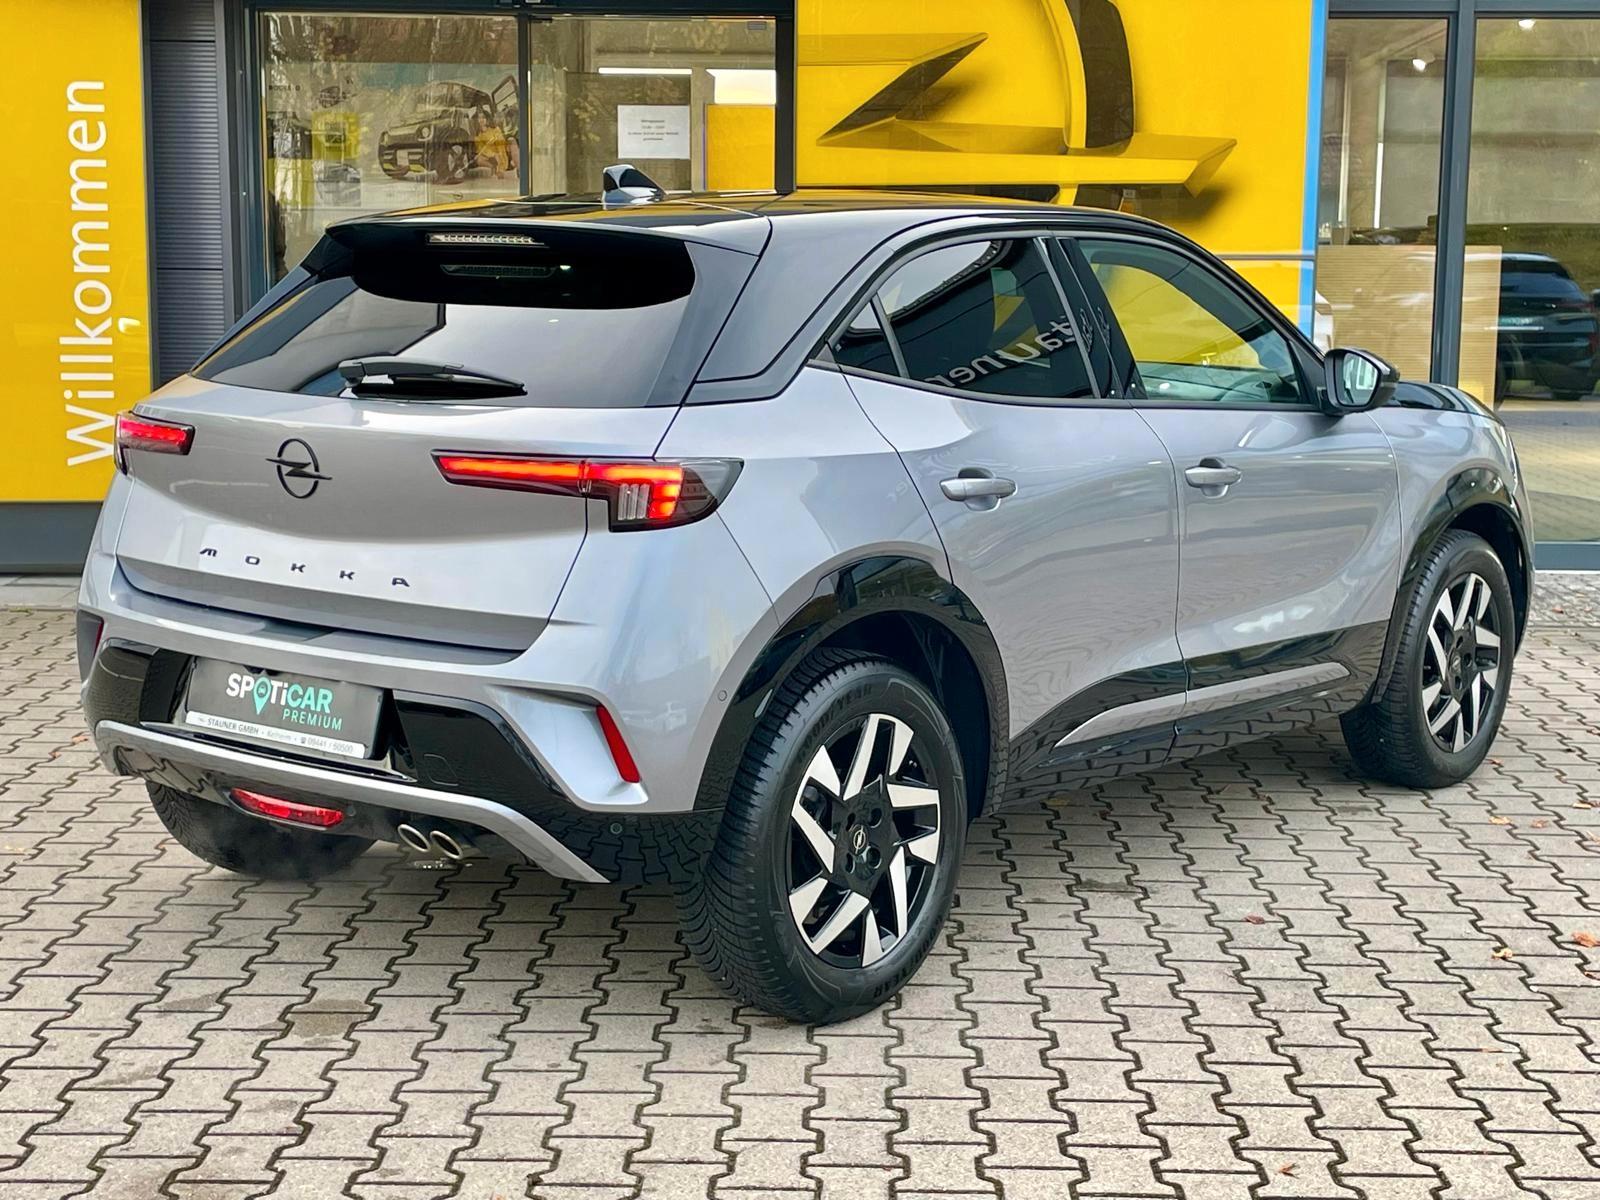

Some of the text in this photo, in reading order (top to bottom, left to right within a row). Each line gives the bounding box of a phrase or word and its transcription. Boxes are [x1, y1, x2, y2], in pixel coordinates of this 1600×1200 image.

[59, 80, 115, 466] Willkommen
[200, 547, 410, 587] MOKKA
[207, 717, 237, 733] STAUNER
[282, 708, 342, 731] PREMIUM
